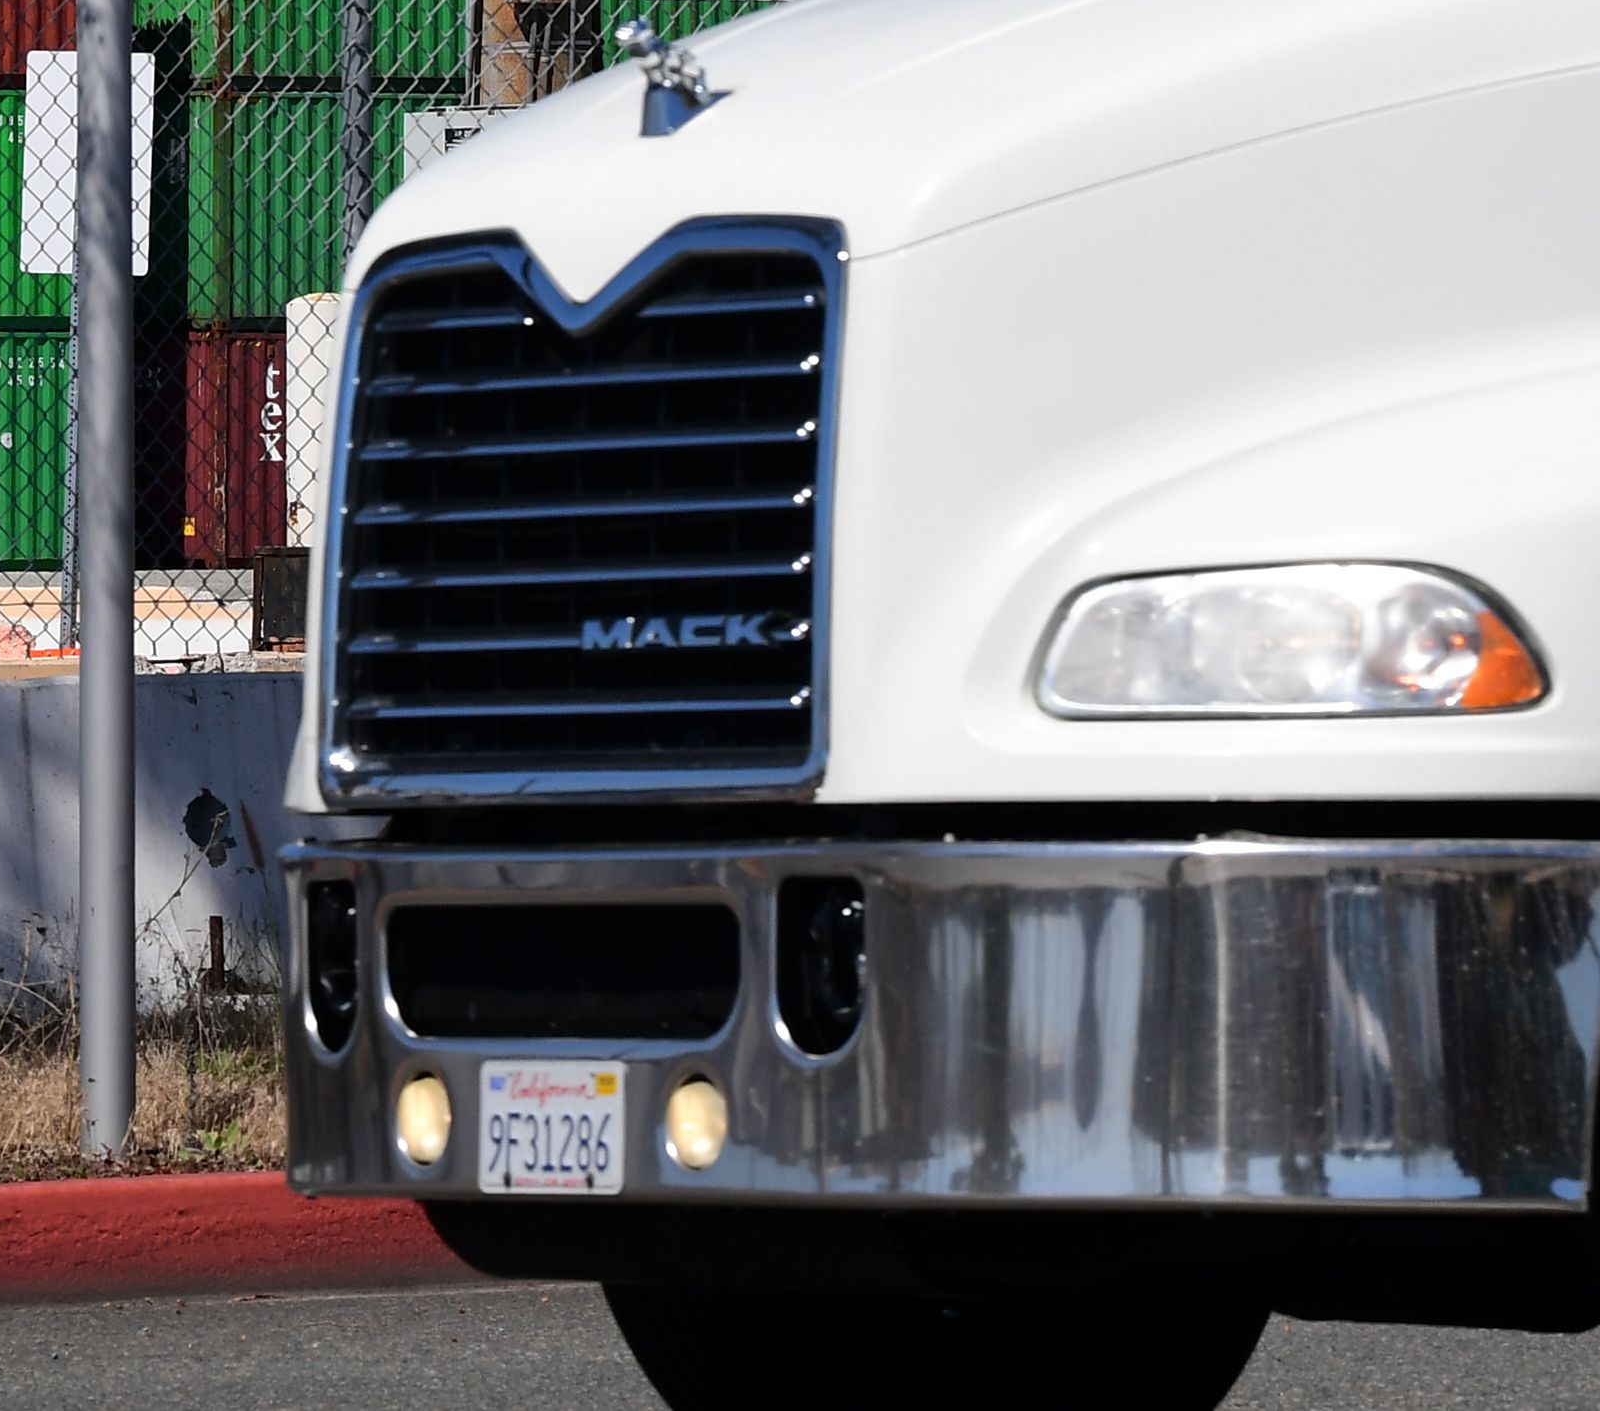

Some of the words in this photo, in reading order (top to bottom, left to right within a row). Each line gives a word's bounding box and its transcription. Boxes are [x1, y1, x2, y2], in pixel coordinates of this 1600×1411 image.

[581, 614, 770, 650] MACK
[509, 1070, 596, 1108] California
[488, 1111, 612, 1173] 9F31286
